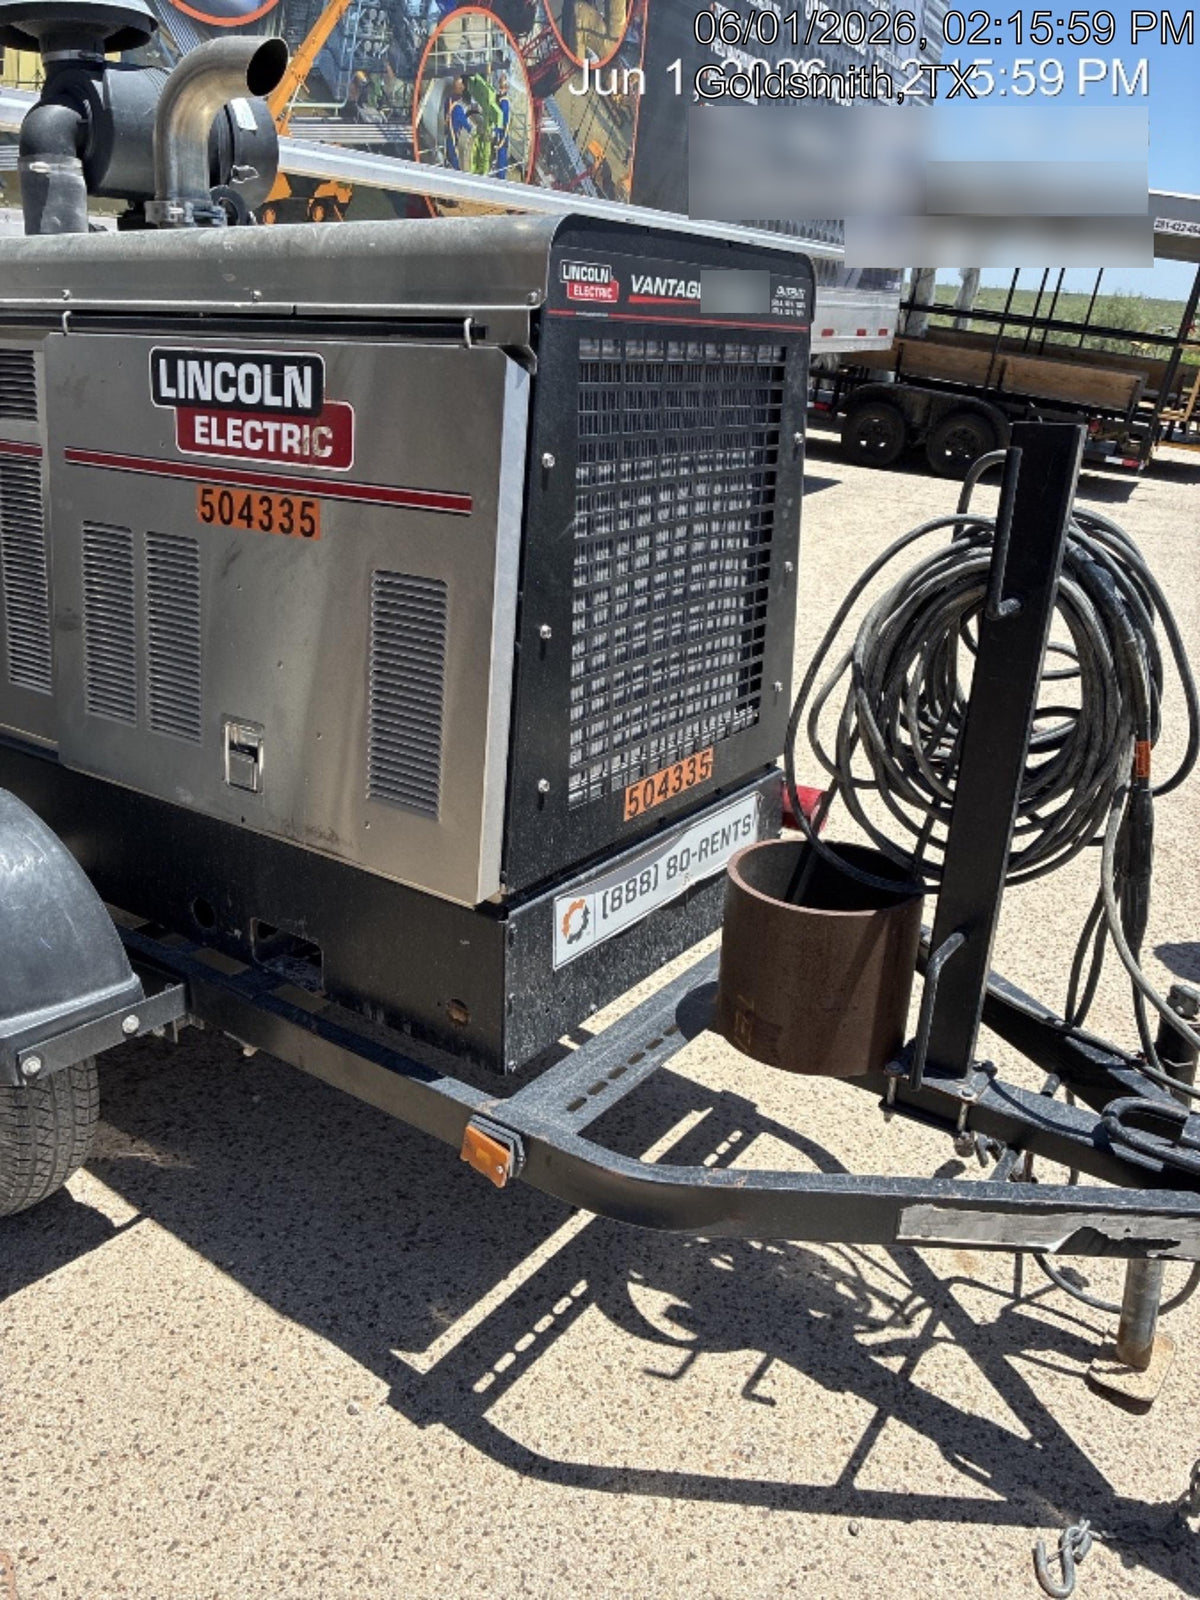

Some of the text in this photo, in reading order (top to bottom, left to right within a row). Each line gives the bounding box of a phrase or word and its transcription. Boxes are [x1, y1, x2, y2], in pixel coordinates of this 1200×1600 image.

[562, 263, 609, 284] LINCOLN
[573, 283, 613, 300] ELECTRIC
[158, 358, 313, 409] LINCOLN
[194, 415, 334, 458] ELECTRIC
[200, 488, 316, 538] 504335
[626, 750, 713, 817] 504335
[665, 813, 752, 881] 80-RENTS
